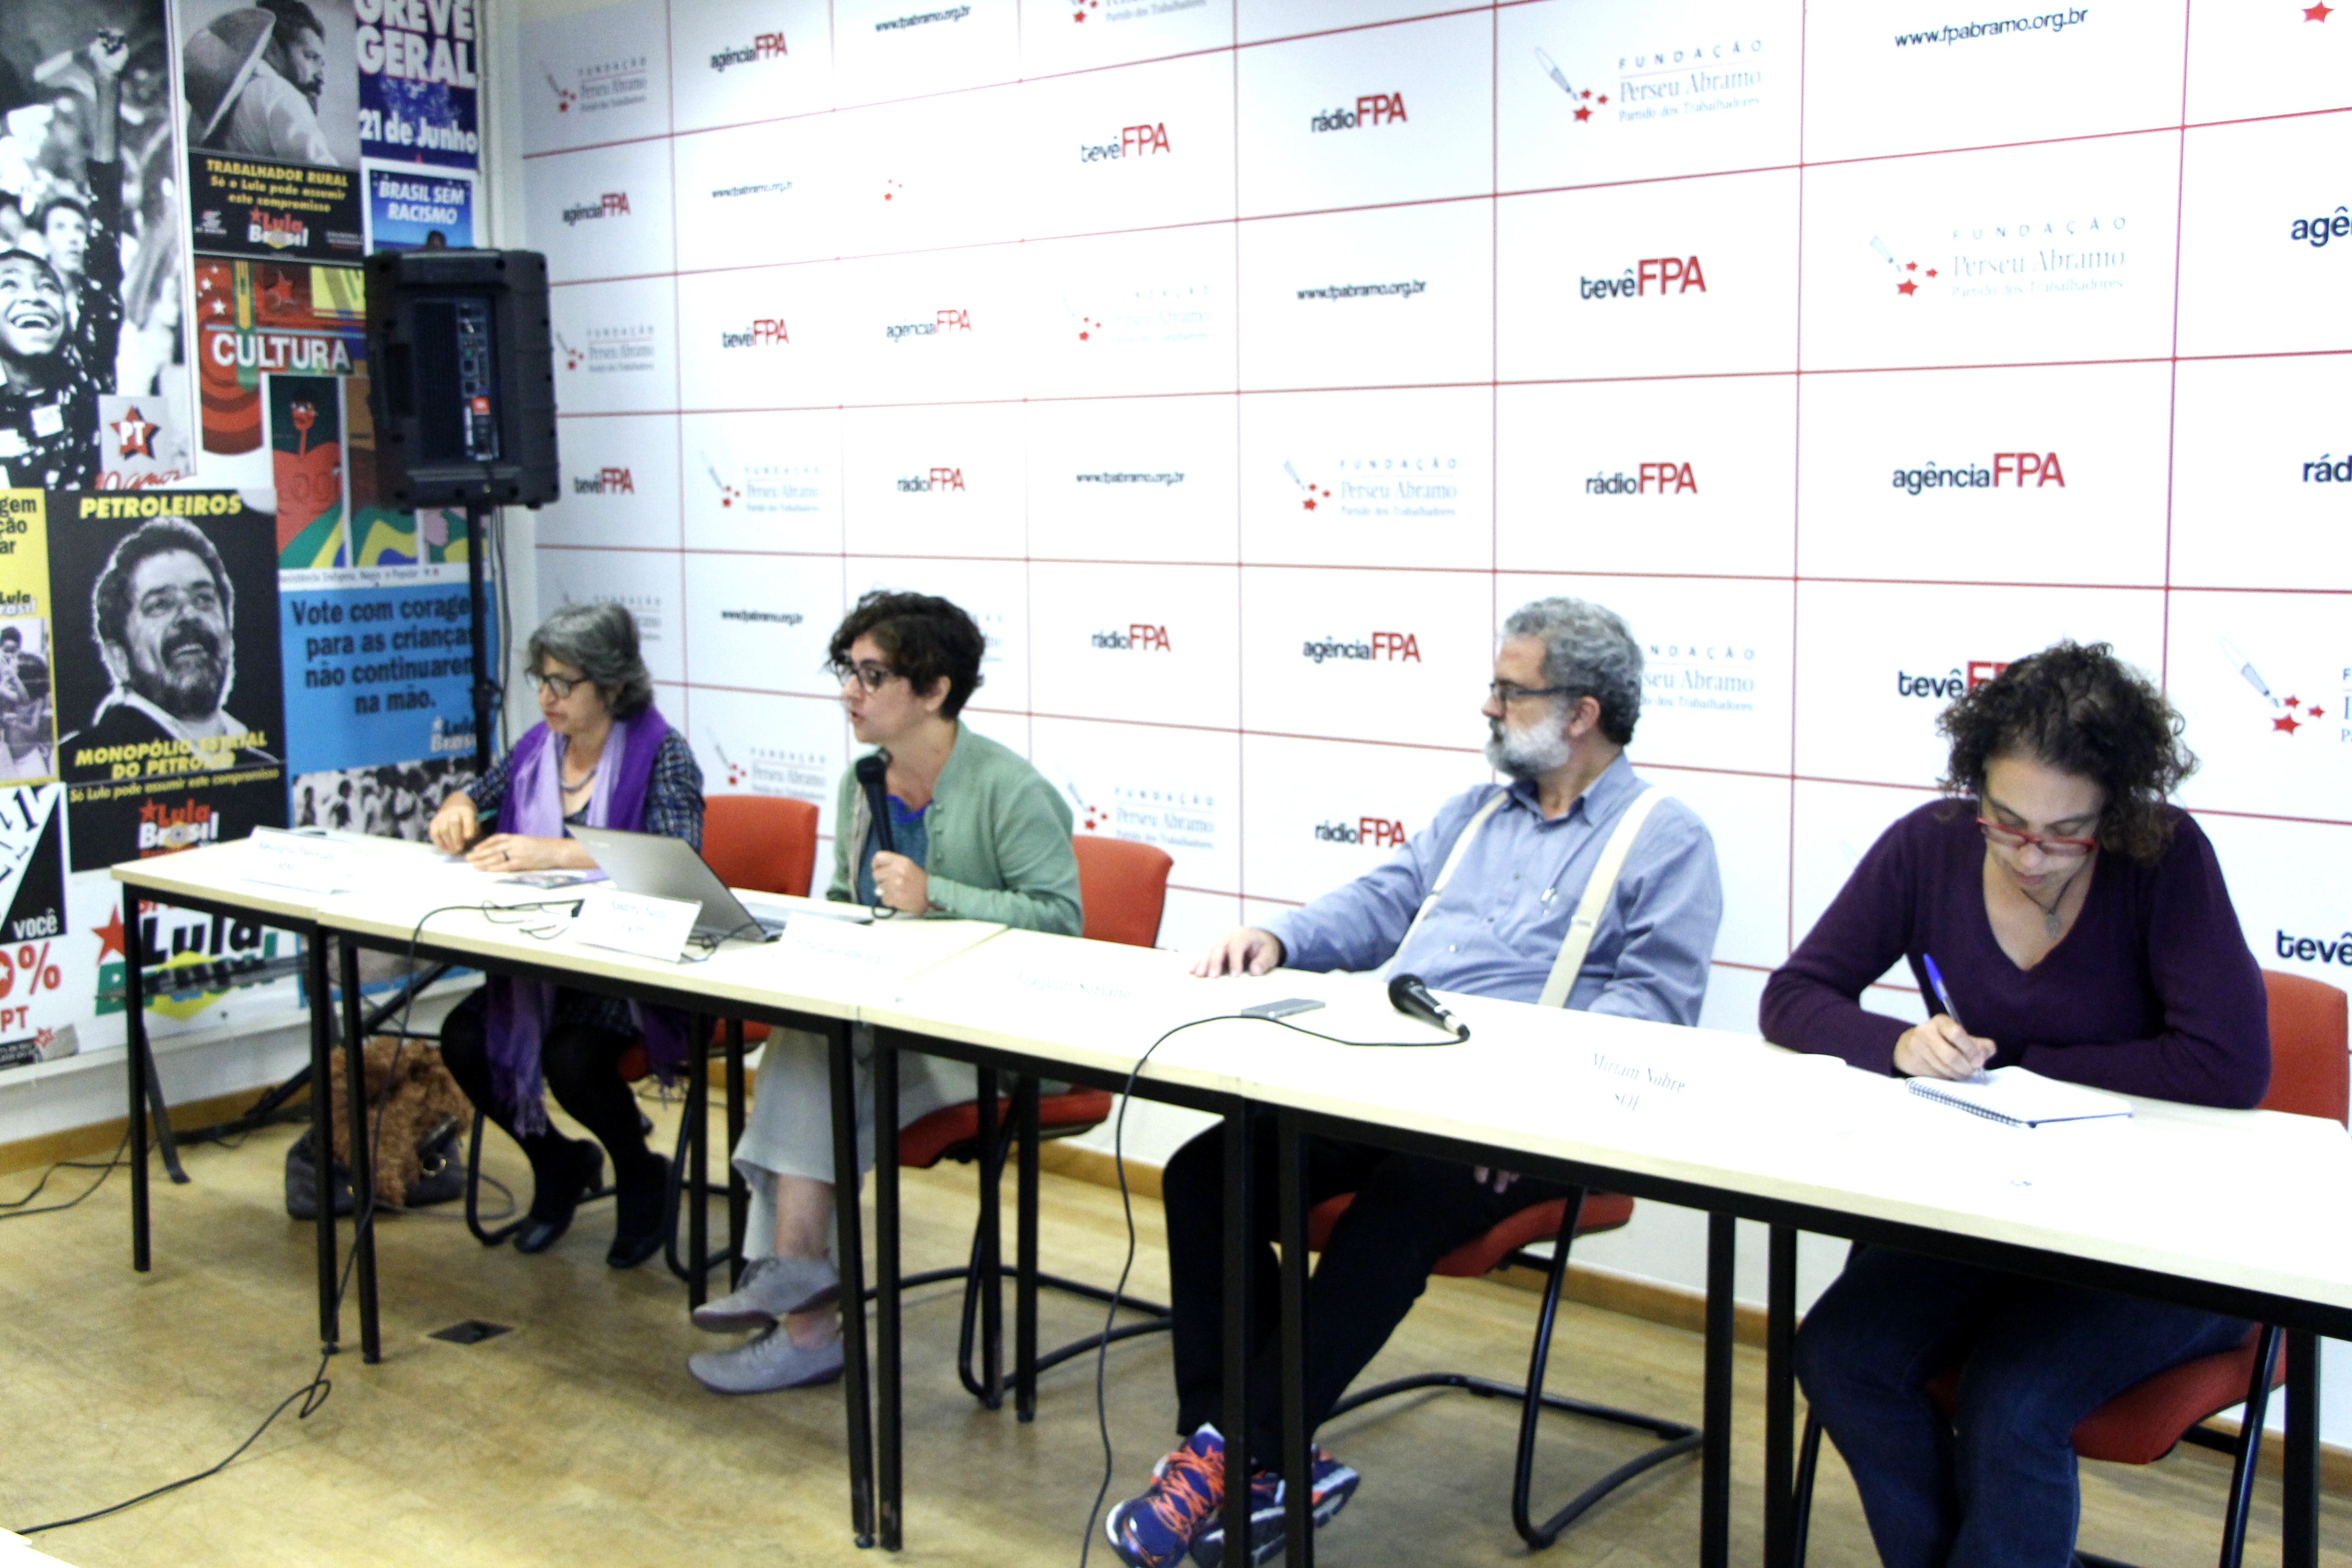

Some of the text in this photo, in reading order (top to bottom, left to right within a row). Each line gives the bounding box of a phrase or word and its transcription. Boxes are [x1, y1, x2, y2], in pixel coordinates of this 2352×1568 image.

[1895, 7, 2089, 47] www.fpabramo.org.br
[357, 25, 476, 88] GERAL
[1618, 39, 1762, 70] FUNDAÇÃO
[1620, 70, 1762, 103] Perseu Abramo
[1311, 92, 1408, 132] rádioFPA
[359, 109, 478, 154] 21 de Junho
[1081, 122, 1171, 162] tevêFPA
[206, 159, 348, 187] TRABALHADOR RURAL
[378, 181, 465, 205] BRASIL SEM
[262, 212, 304, 233] Lula
[388, 202, 458, 225] RACISMO
[1952, 216, 2127, 241] FUNDAÇÃO
[2290, 206, 2352, 248] agê
[1580, 255, 1707, 300] tevêFPA
[1953, 248, 2126, 277] Perseu Abramo
[212, 333, 352, 368] CULTURA
[120, 421, 146, 446] PT
[1586, 461, 1698, 495] rádioFPA
[1892, 452, 2066, 496] agênciaFPA
[79, 494, 243, 519] PETROLEIROS
[291, 595, 471, 626] Vote com corage
[306, 626, 472, 662] para as criança
[1303, 632, 1421, 665] agênciaFPA
[1649, 644, 1755, 661] NDAÇÃO
[305, 660, 346, 689] não
[1642, 669, 1756, 693] seu Abramo
[354, 694, 380, 715] na
[74, 738, 192, 767] MONOPÓLIO
[112, 762, 141, 780] DO
[157, 799, 211, 827] Lula
[1315, 817, 1406, 849] rádioFPA
[140, 913, 262, 966] Lula
[1, 1005, 29, 1034] PT
